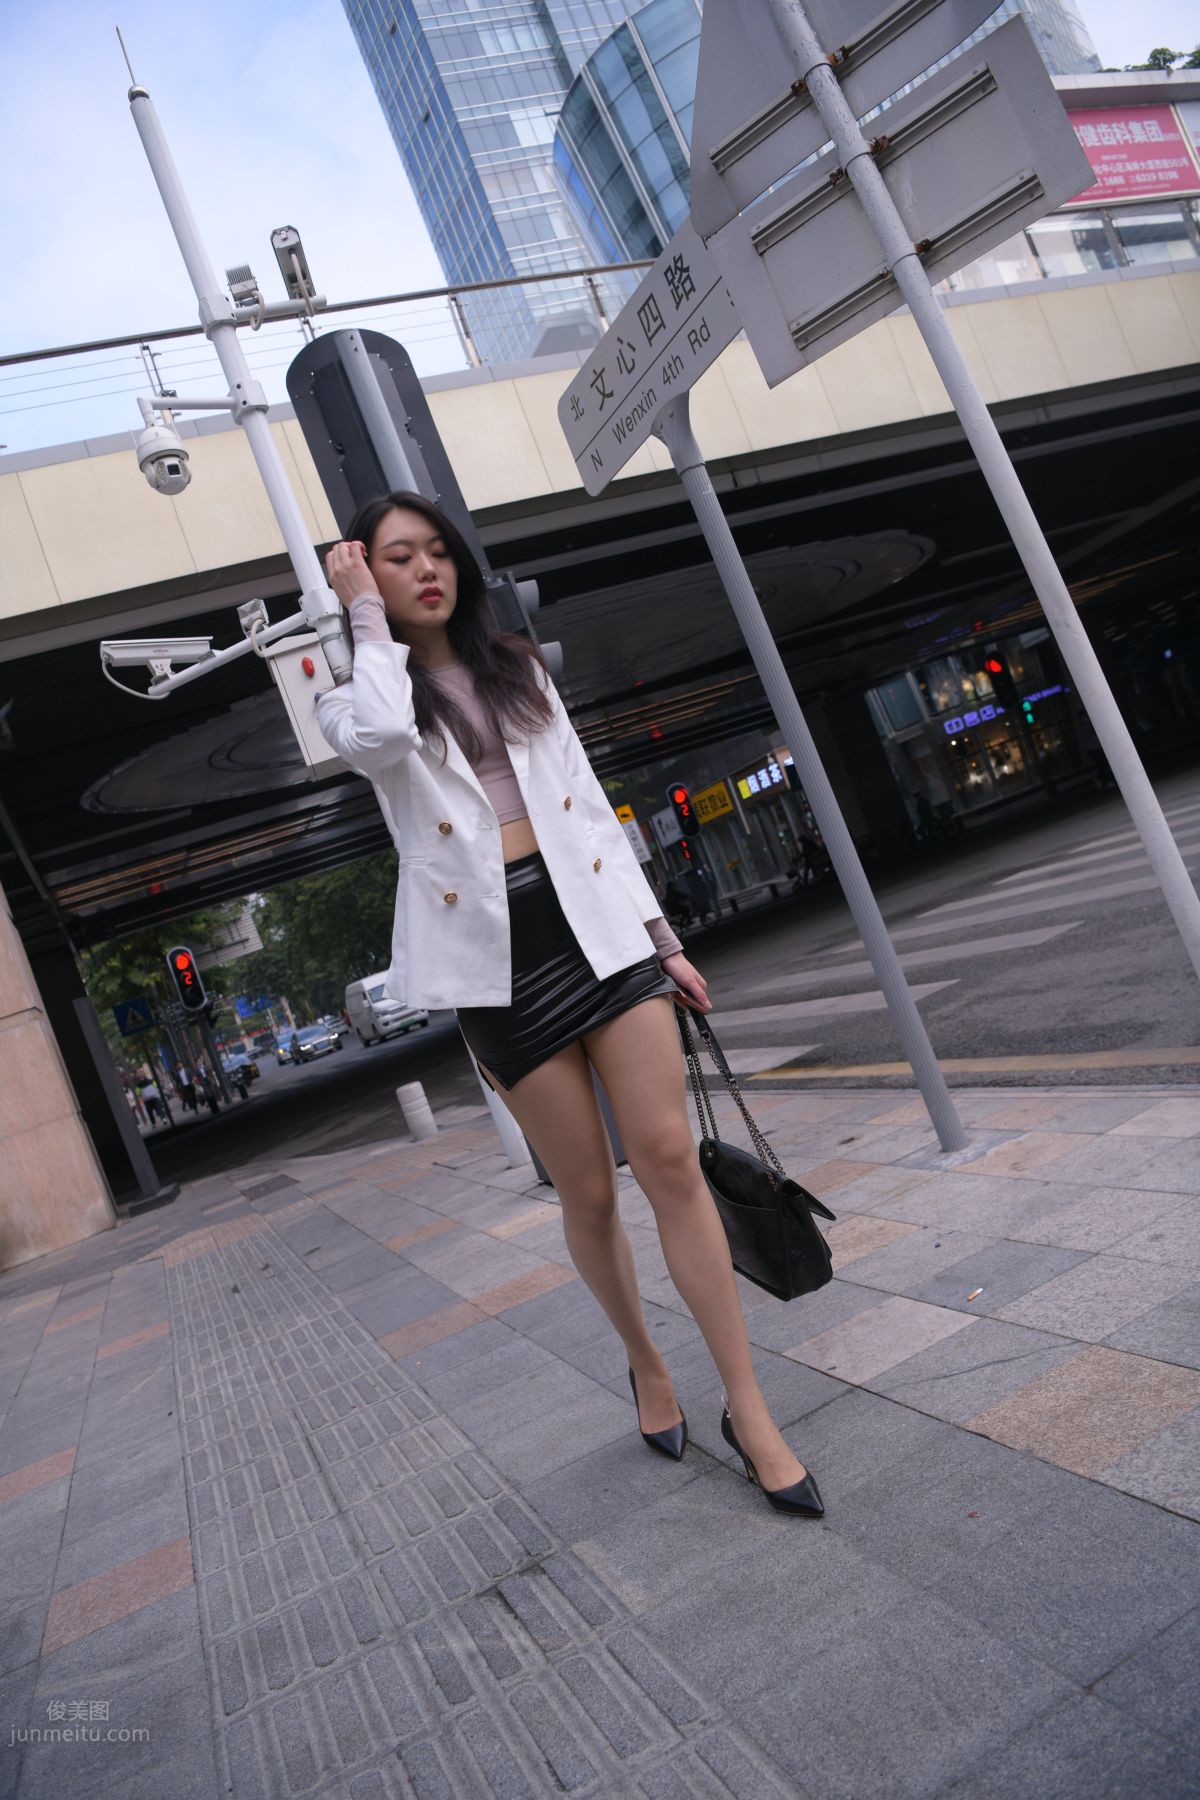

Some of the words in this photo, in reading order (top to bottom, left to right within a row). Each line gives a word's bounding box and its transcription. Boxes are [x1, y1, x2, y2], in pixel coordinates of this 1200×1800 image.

[1073, 119, 1164, 147] 健齿科集团
[570, 394, 585, 422] 北
[590, 253, 696, 412] 文心四路
[590, 448, 604, 472] N
[611, 388, 657, 445] Wenxin
[662, 354, 684, 386] 4th
[687, 317, 711, 355] Rd
[183, 971, 192, 985] 2
